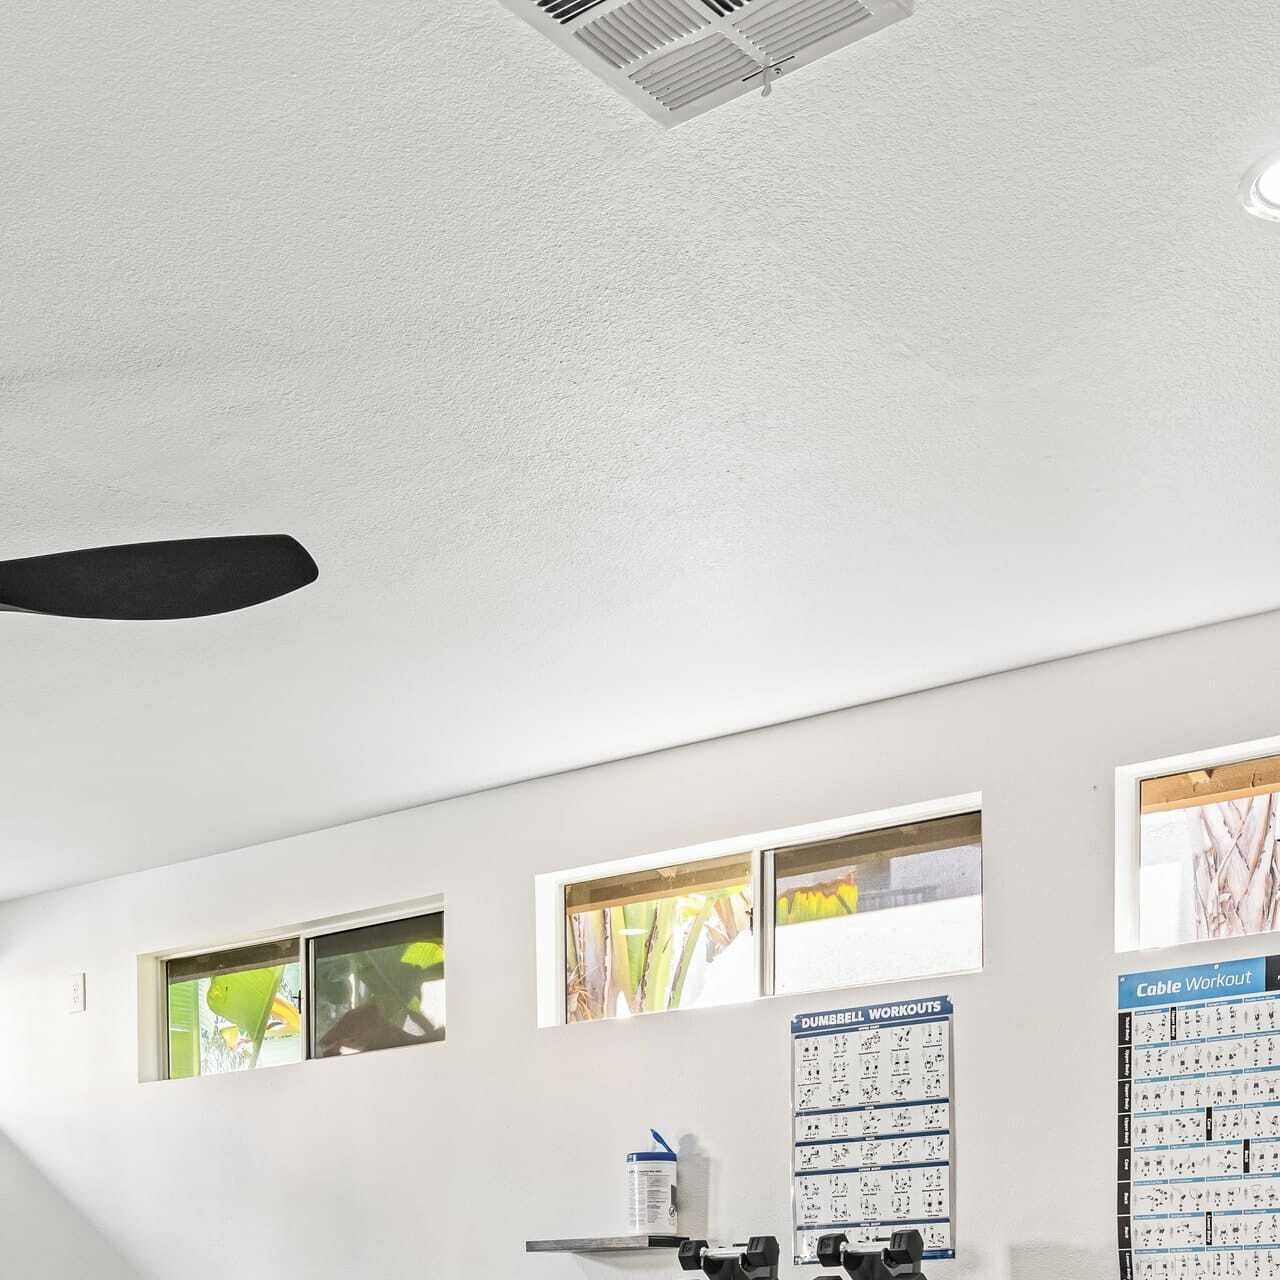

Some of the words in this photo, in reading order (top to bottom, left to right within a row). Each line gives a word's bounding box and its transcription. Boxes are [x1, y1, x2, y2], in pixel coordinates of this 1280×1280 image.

[1136, 981, 1182, 998] Cable
[1185, 970, 1254, 991] Workout
[801, 1010, 865, 1029] DUMBBELL
[869, 1000, 942, 1020] WORKOUTS
